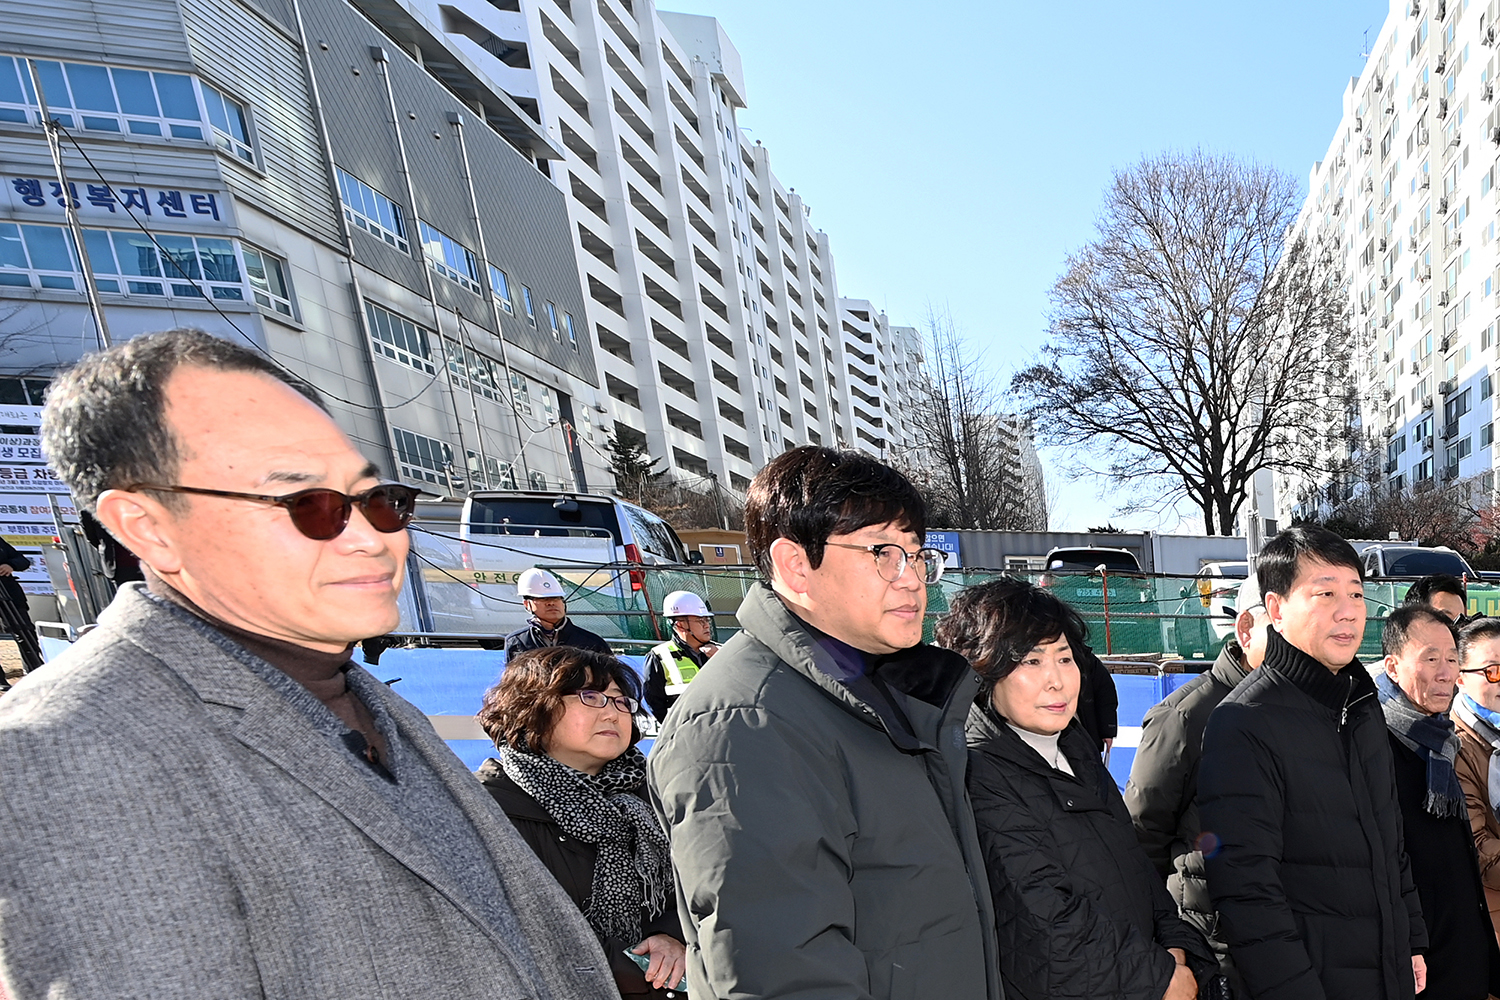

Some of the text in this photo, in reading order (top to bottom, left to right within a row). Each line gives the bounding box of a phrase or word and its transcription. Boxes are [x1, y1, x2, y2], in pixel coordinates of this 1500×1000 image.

[12, 178, 220, 221] 행정복지센터
[18, 448, 41, 458] 모집
[8, 526, 39, 534] 부평1동
[474, 572, 507, 584] 안전
